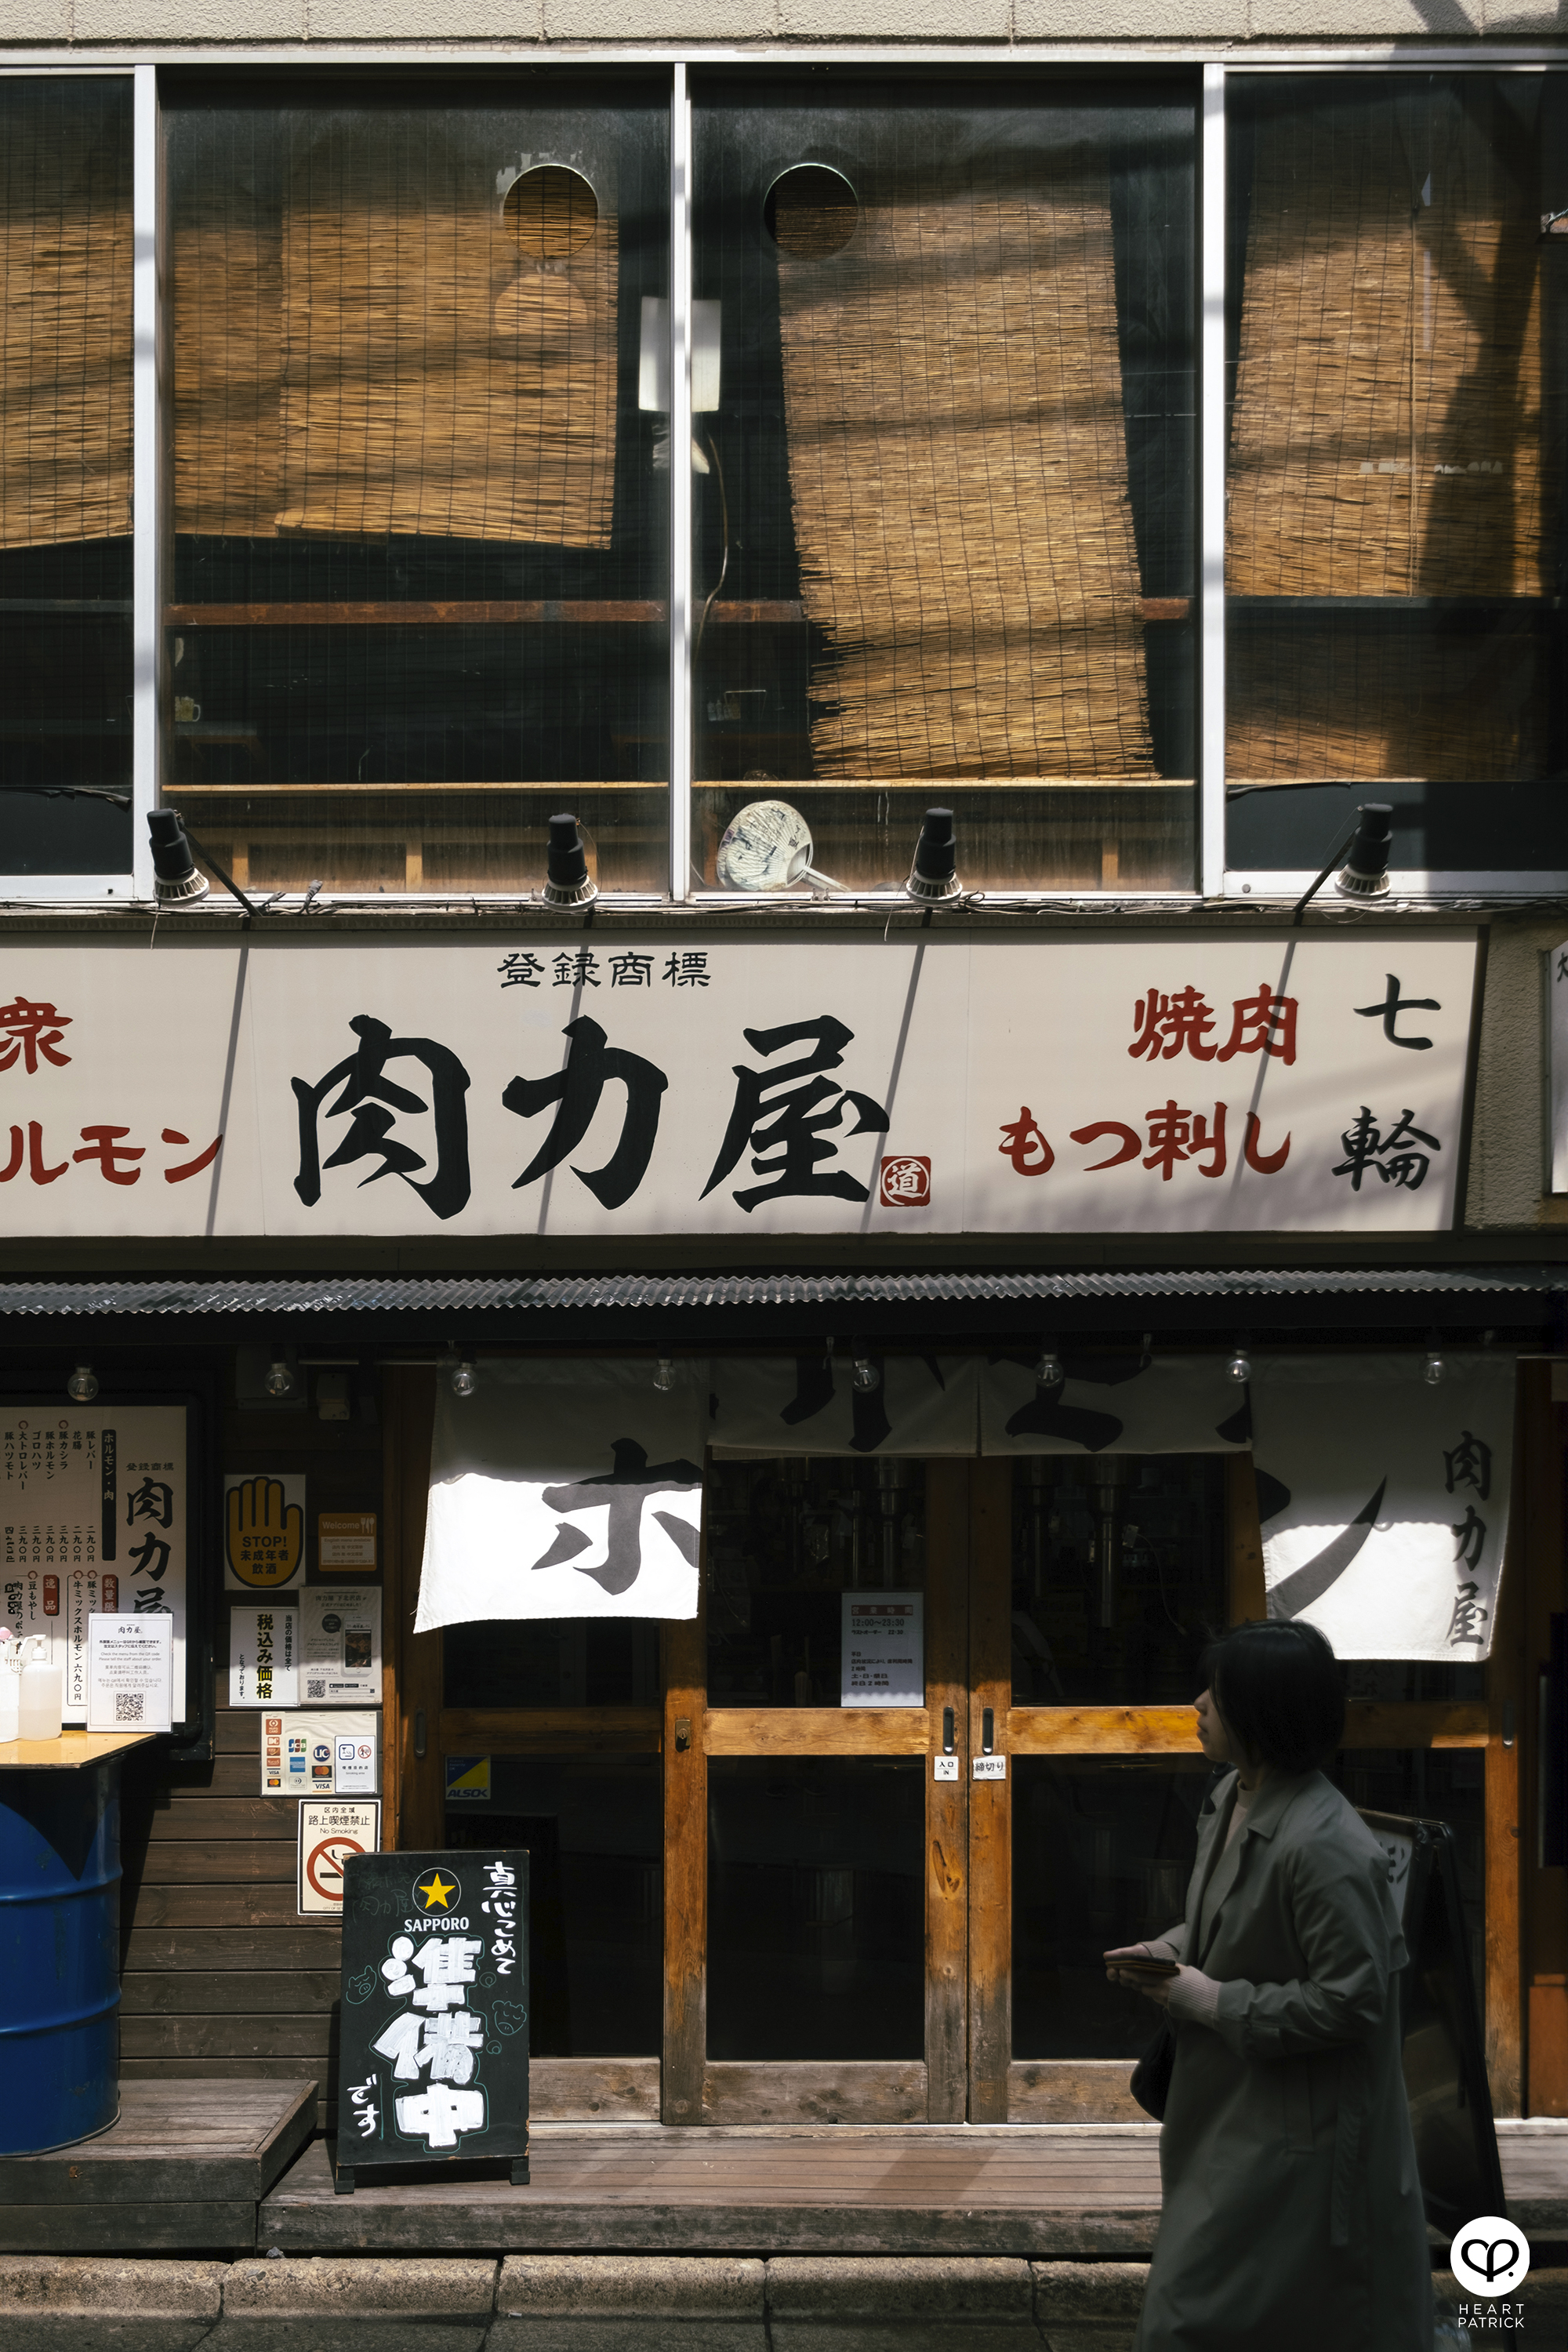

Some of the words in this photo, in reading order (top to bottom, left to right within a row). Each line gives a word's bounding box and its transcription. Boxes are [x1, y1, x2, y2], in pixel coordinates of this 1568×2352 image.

[496, 951, 712, 988] 登録商標
[0, 996, 73, 1074] 衆
[1127, 983, 1298, 1067] 焼肉
[1331, 974, 1442, 1192] 七輪
[290, 1014, 891, 1221] 肉力屋
[0, 1120, 223, 1186] ルモン
[999, 1100, 1292, 1181] もつ刺し
[887, 1162, 922, 1199] 道
[4, 1432, 15, 1481] 豚ハツモト
[18, 1432, 29, 1491] 大トロレバー
[31, 1431, 42, 1470] ゴロハツ
[45, 1431, 56, 1480] 豚ホルモン
[59, 1431, 68, 1471] 豚カシラ
[85, 1430, 96, 1470] 豚レバー
[103, 1433, 115, 1501] ホルモン・肉
[126, 1462, 175, 1472] 登録商標
[242, 1536, 287, 1548] STOP!
[321, 1521, 360, 1530] Welcome
[1441, 1429, 1494, 1648] 肉力屋
[241, 1550, 289, 1561] 未成年者
[252, 1563, 277, 1574] 飲酒
[27, 1581, 38, 1621] 豆もやし
[73, 1581, 83, 1661] 牛ミックスホルモン
[851, 1606, 913, 1615] 営業時間
[256, 1614, 274, 1699] 税込み価格
[314, 1749, 330, 1758] UC
[975, 1762, 1004, 1772] 締切り
[447, 1789, 488, 1798] ALSOK
[308, 1815, 370, 1825] 路上喫煙禁止
[404, 1916, 470, 1932] SAPPORO
[481, 1861, 517, 1975] 真心こめて
[372, 1936, 484, 2148] 準備中
[347, 2074, 379, 2137] です
